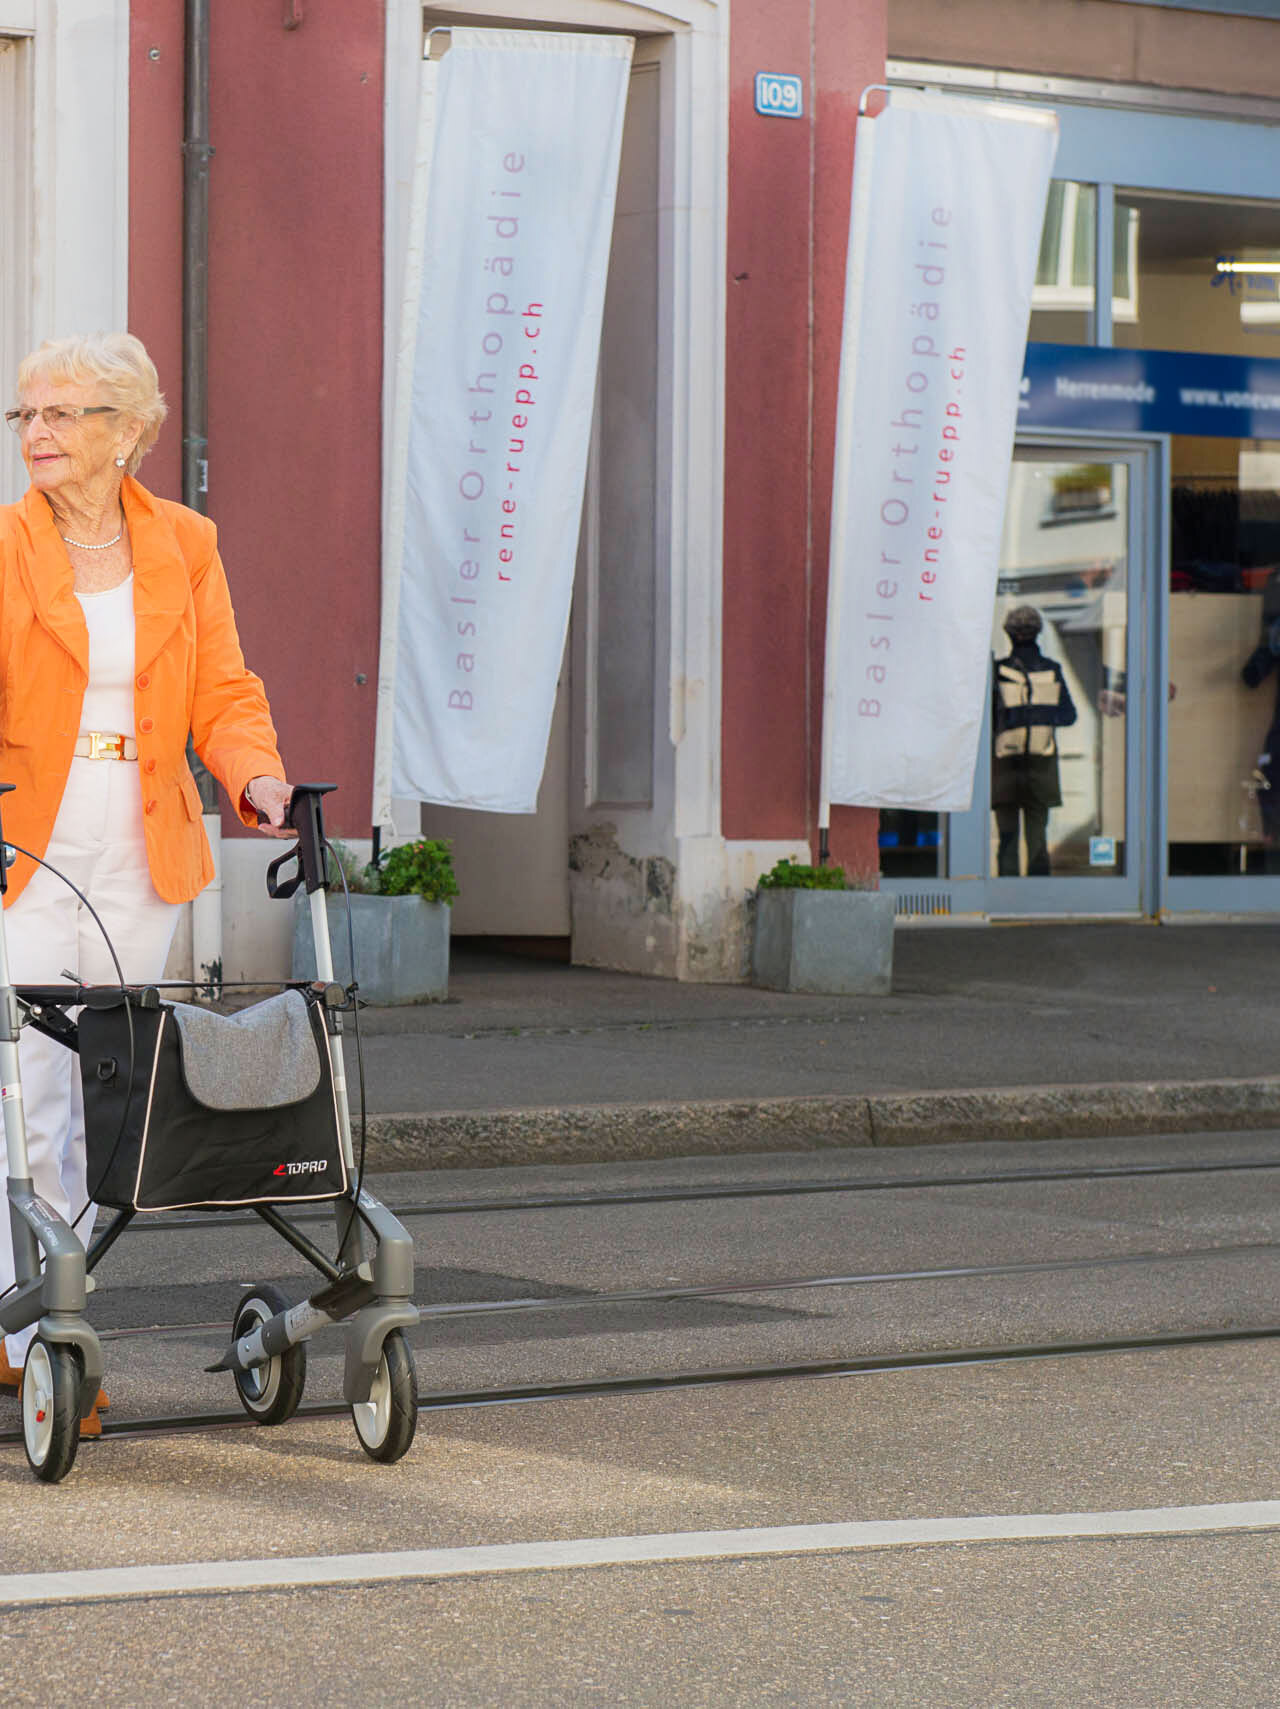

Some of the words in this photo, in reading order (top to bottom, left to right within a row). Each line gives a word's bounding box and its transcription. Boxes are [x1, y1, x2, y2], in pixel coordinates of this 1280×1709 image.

[762, 79, 797, 109] 109
[458, 151, 525, 501] Orthopädie
[497, 301, 544, 582] rene-ruepp.ch
[857, 551, 902, 719] Basler
[880, 206, 952, 526] Orthopädie
[919, 346, 967, 602] rene-ruepp.ch
[447, 527, 481, 712] Basler
[286, 1160, 328, 1175] TOPRO
